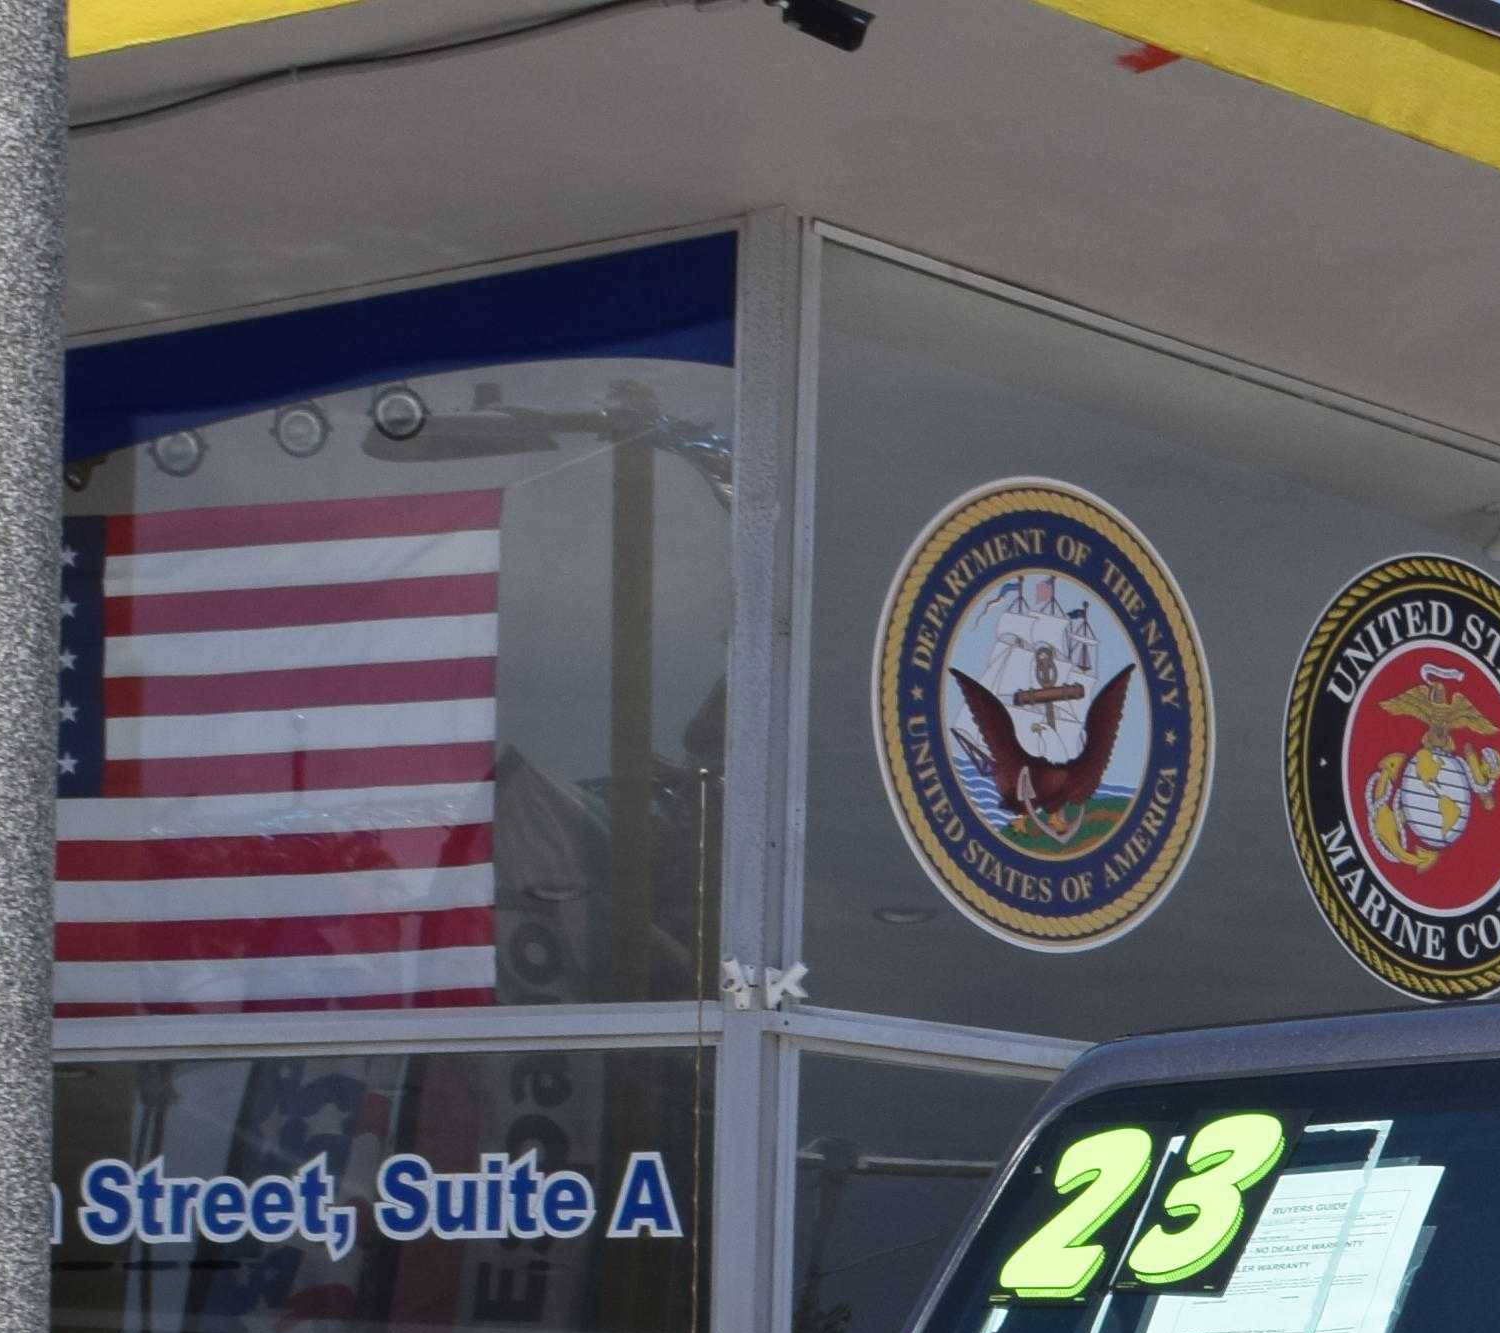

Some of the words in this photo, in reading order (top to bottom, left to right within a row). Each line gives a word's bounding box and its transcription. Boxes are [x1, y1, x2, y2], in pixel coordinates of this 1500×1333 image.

[914, 528, 1046, 671] DEPARTMENT
[1056, 535, 1092, 567] OF
[1101, 558, 1145, 620] THE
[1141, 618, 1181, 710] NAVY
[1326, 599, 1453, 704] UNITED
[907, 715, 966, 843] UNITED
[963, 839, 1052, 903] STATES
[1061, 870, 1093, 903] OF
[1104, 767, 1178, 887] AMERICA
[1320, 820, 1447, 961] MARINE
[78, 1154, 358, 1262] Street,
[375, 1148, 597, 1240] Suite
[607, 1152, 684, 1238] A
[999, 1112, 1287, 1299] 23
[1272, 1203, 1314, 1215] BUYERS
[1316, 1202, 1348, 1212] GUIDE
